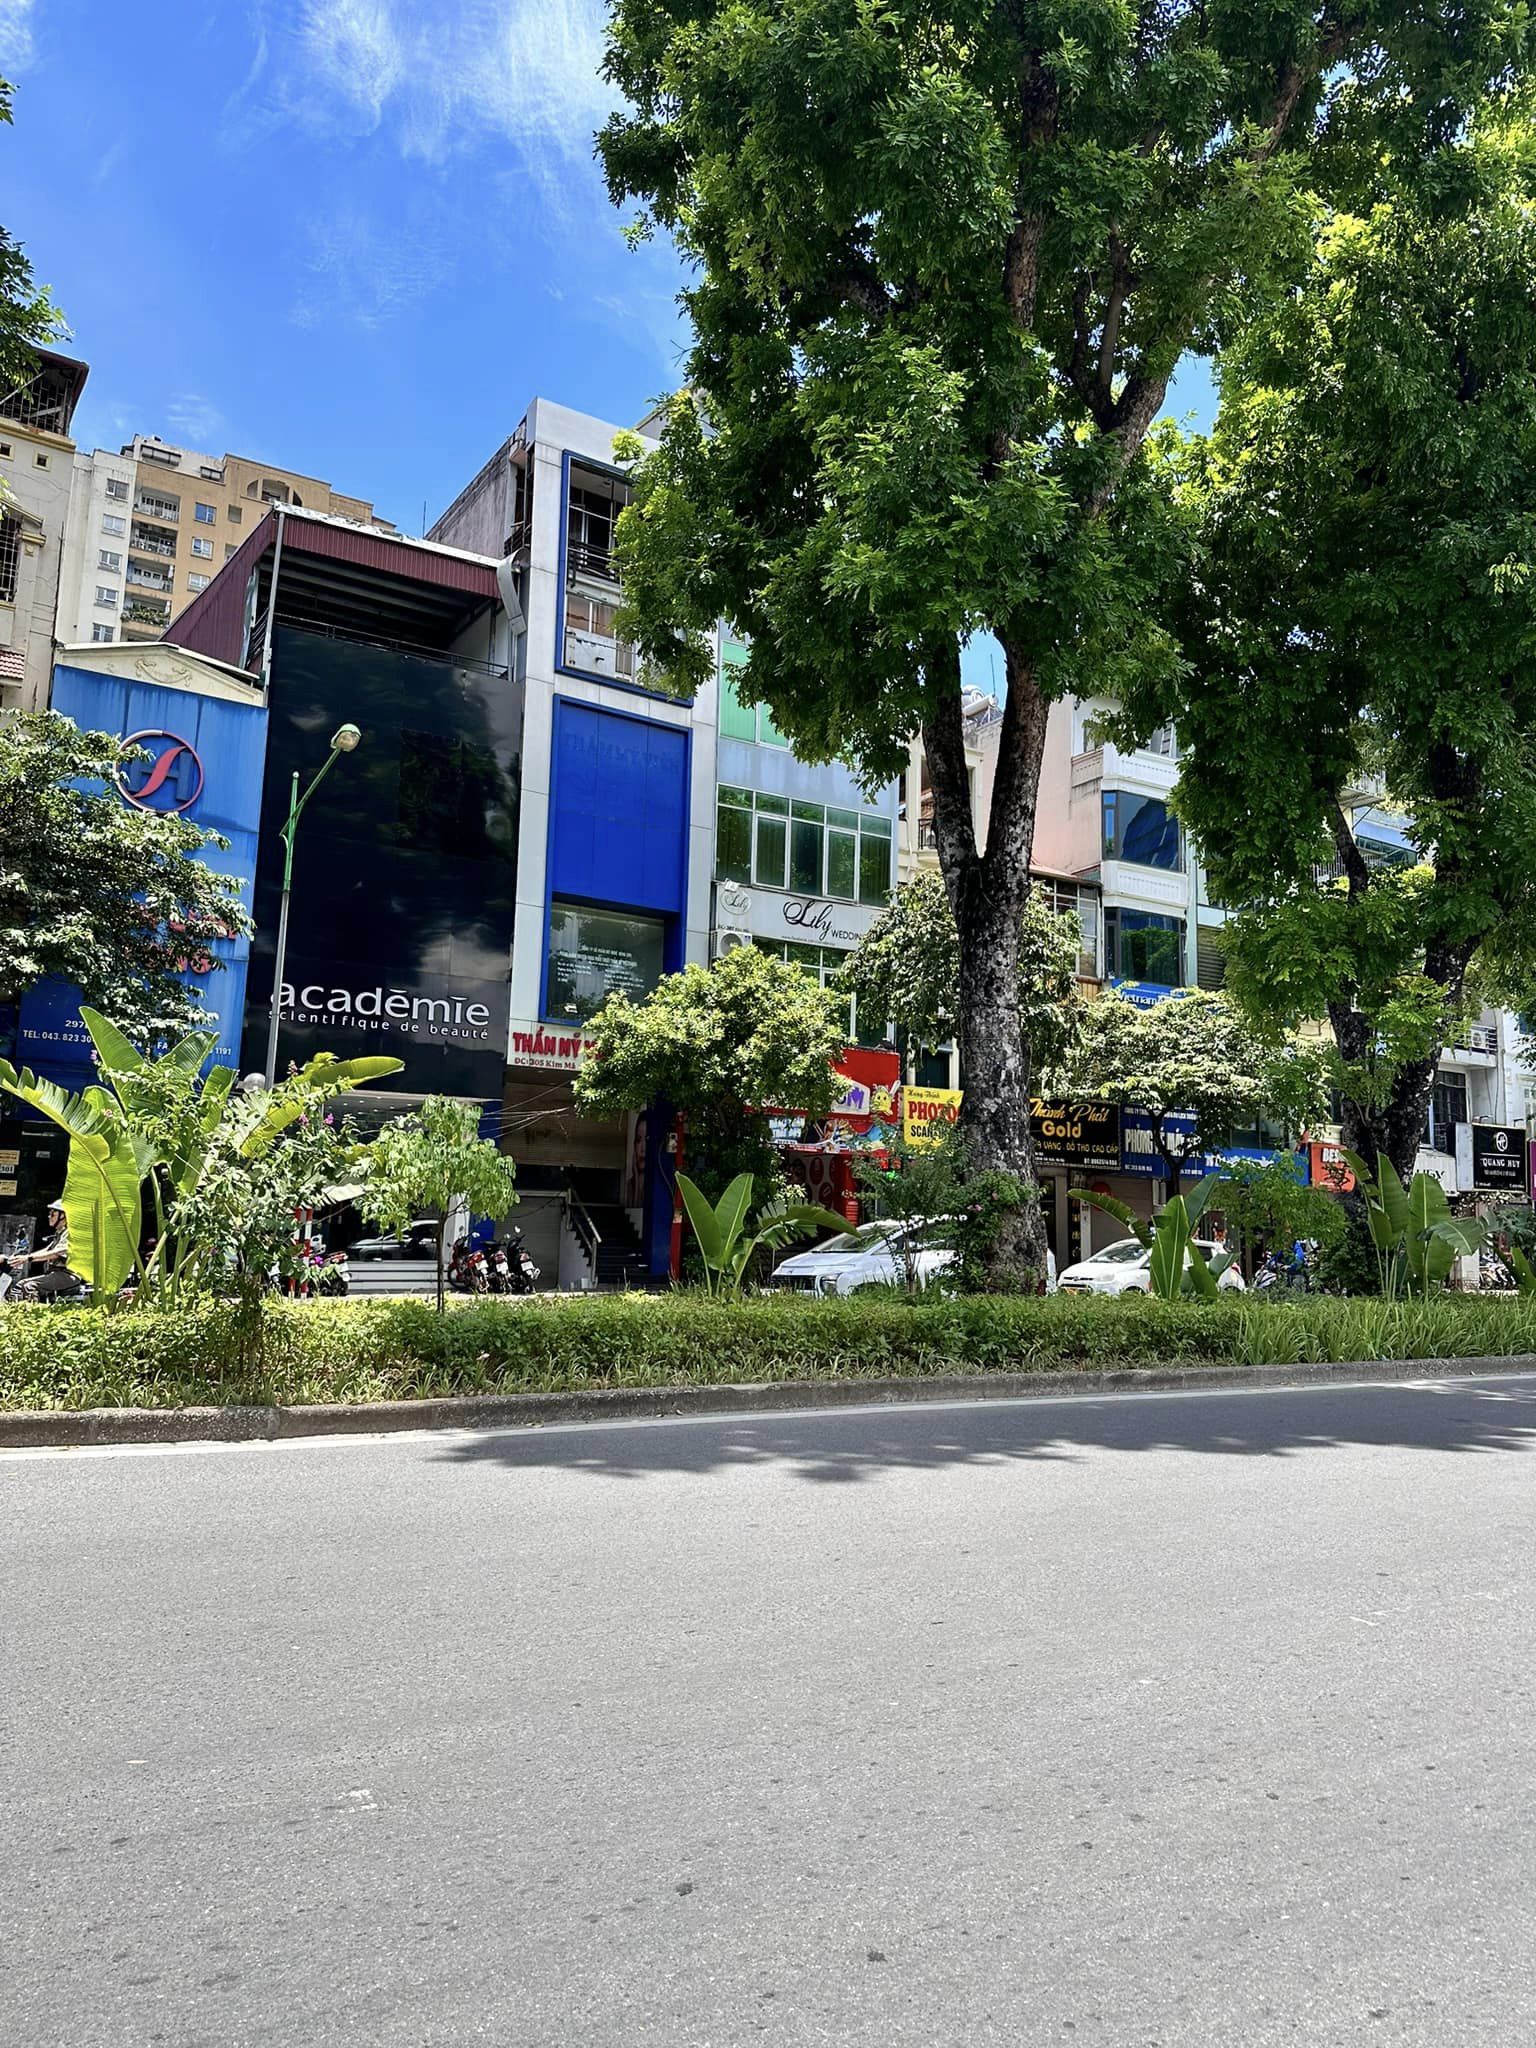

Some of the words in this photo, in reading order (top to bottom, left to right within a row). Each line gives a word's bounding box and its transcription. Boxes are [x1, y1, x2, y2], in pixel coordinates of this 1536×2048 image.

[783, 899, 834, 940] Lily
[831, 930, 862, 941] WEDDIN
[23, 1030, 41, 1040] TEL:
[62, 1033, 80, 1043] 823
[400, 1021, 419, 1033] de
[429, 1023, 488, 1040] beauté
[545, 1059, 562, 1068] Kim
[1029, 1098, 1066, 1119] Thành
[1069, 1103, 1110, 1123] Phát
[1042, 1120, 1082, 1138] Gold
[1482, 1158, 1506, 1167] QUANG
[1507, 1160, 1521, 1168] HUY
